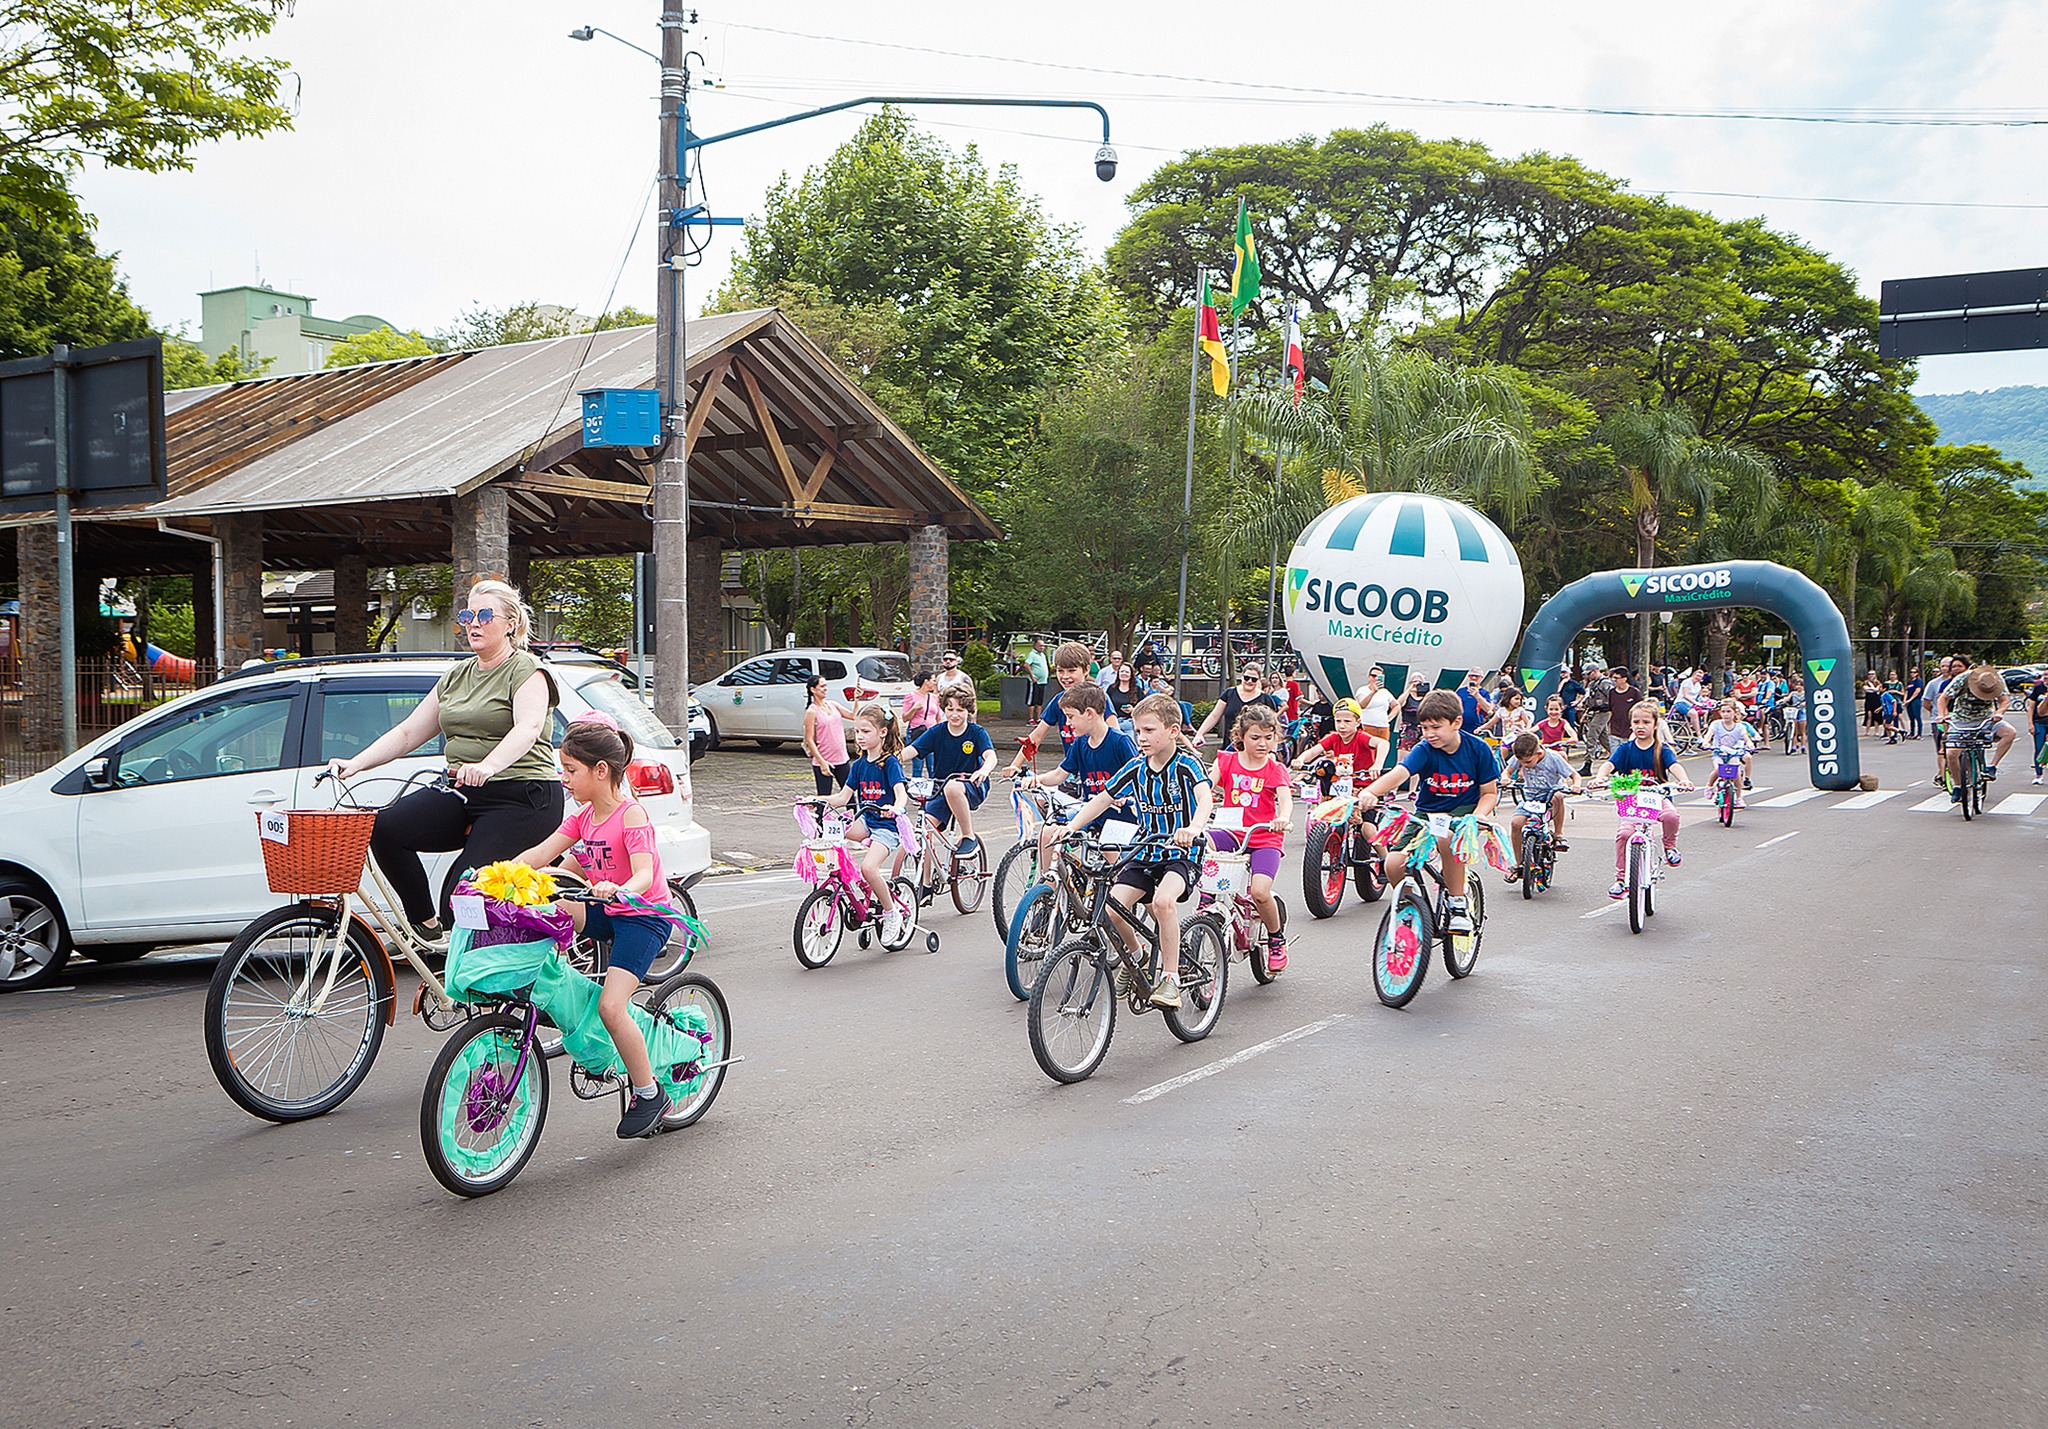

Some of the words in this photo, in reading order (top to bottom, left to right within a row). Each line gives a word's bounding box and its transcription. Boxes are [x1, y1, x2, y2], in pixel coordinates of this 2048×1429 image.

[1646, 569, 1731, 594] SICOOB
[1305, 577, 1450, 624] SICOOB
[1664, 589, 1732, 603] MaxiCrédito
[1328, 619, 1443, 647] MaxiCrédito
[1813, 688, 1839, 776] SICOOB
[1231, 773, 1265, 793] YOU
[1140, 799, 1184, 813] Banrisul
[1231, 789, 1261, 808] GOT
[267, 820, 284, 834] 005
